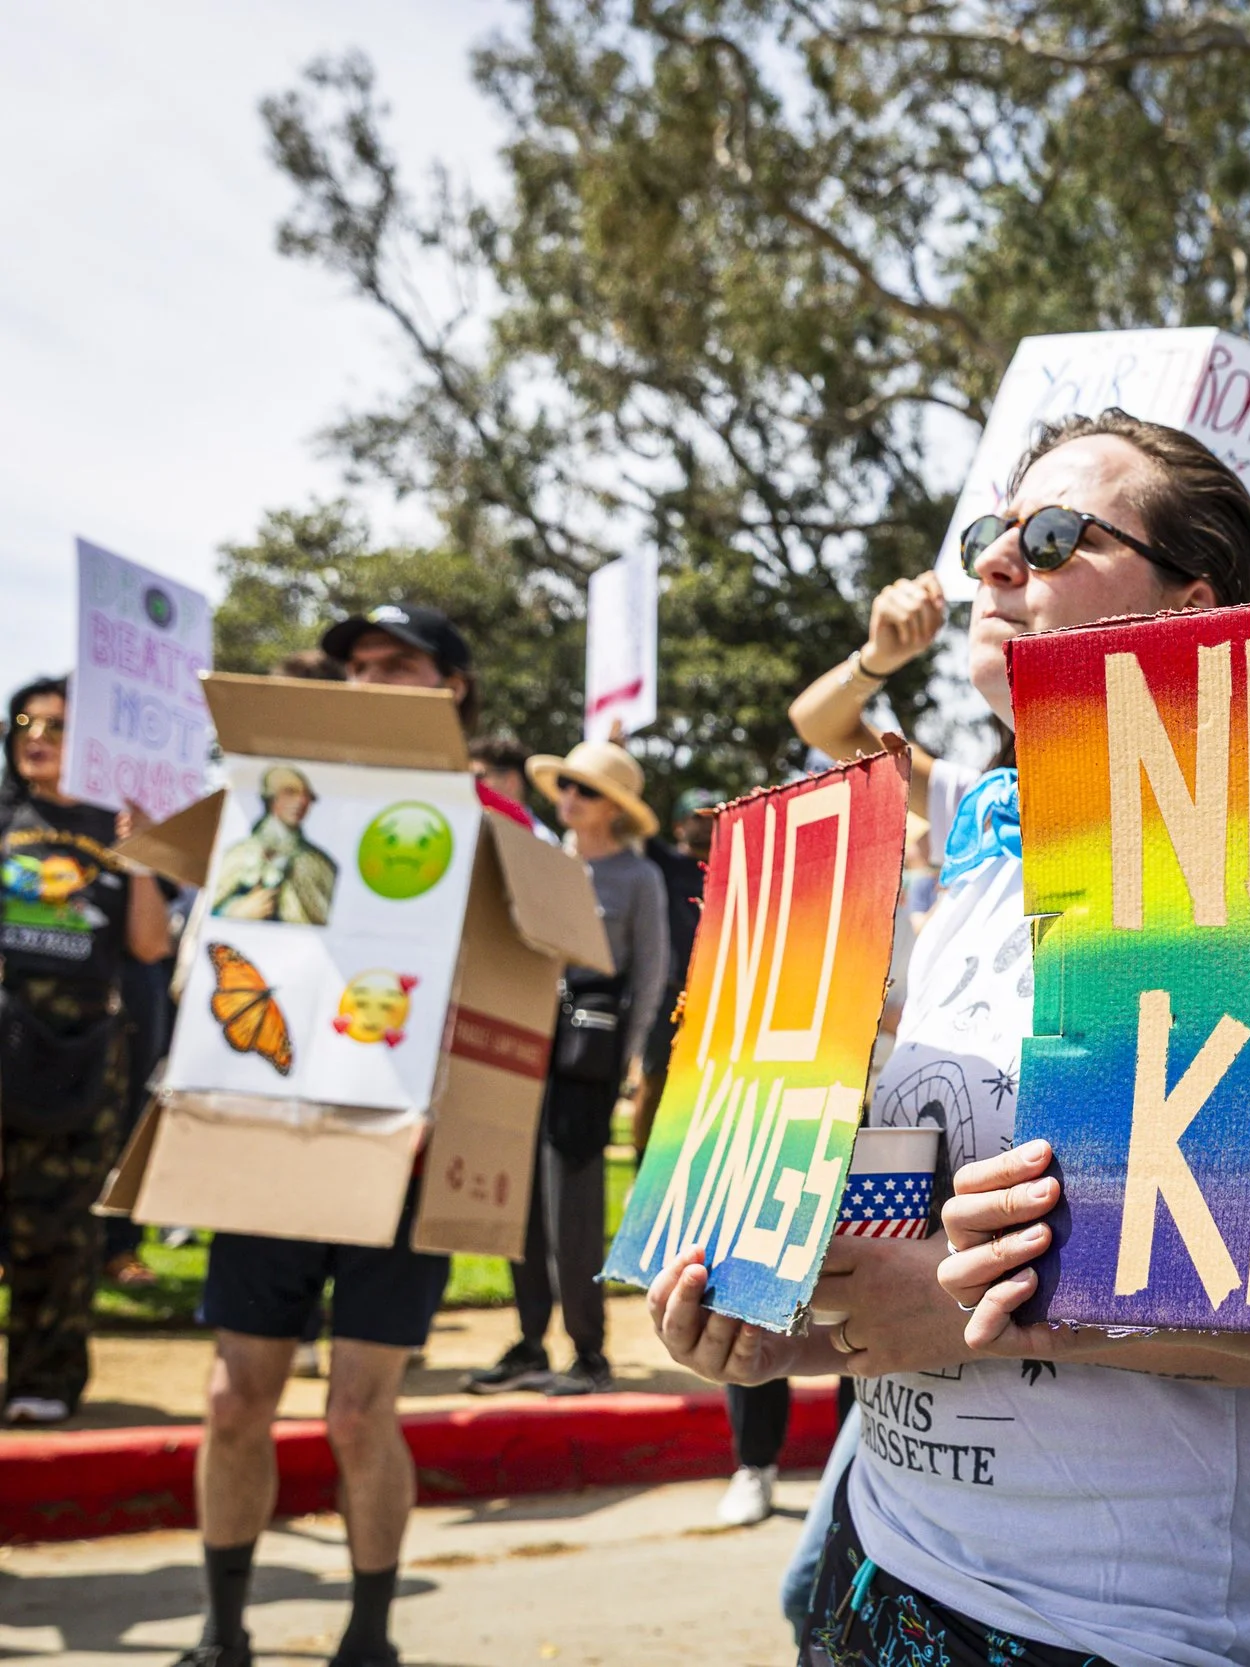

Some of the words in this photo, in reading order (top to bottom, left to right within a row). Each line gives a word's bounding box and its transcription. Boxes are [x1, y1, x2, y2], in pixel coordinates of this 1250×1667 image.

[109, 681, 206, 763] NOT
[697, 780, 851, 1068] NO
[640, 1059, 862, 1282] KINGS
[856, 1377, 933, 1432] LANIS
[861, 1411, 996, 1486] RISSETTE
